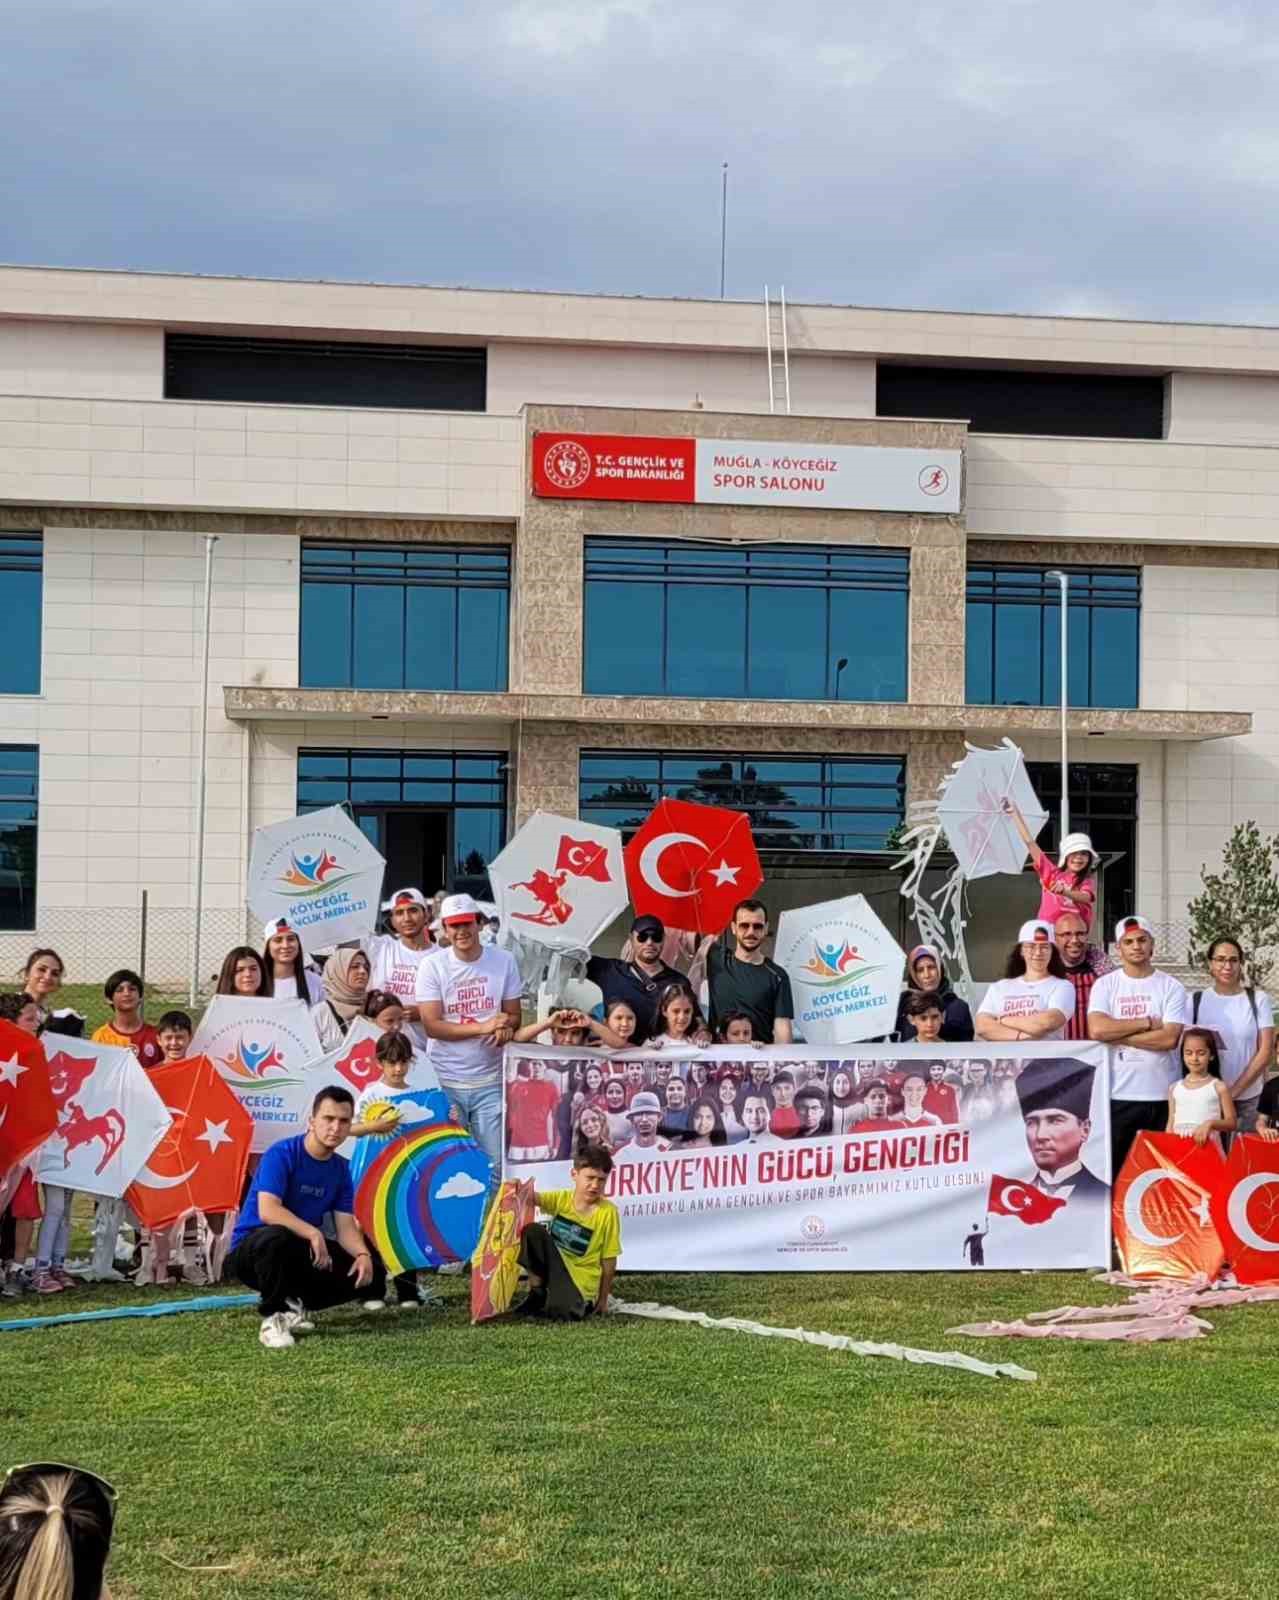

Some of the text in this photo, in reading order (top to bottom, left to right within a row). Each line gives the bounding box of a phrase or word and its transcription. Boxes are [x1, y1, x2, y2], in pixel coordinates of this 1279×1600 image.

[595, 455, 685, 469] T.C. GENÇLİK VE
[713, 455, 762, 468] MUĞLA
[772, 456, 838, 472] KÖYCEĞİZ
[595, 467, 685, 481] SPOR BAKANLIĞI
[713, 473, 825, 491] SPOR SALONU
[604, 1152, 748, 1198] ÜRKİYE'NİN
[843, 1130, 970, 1173] GENÇLİĞİ
[795, 1186, 824, 1202] SPOR
[905, 1174, 940, 1192] KUTLU
